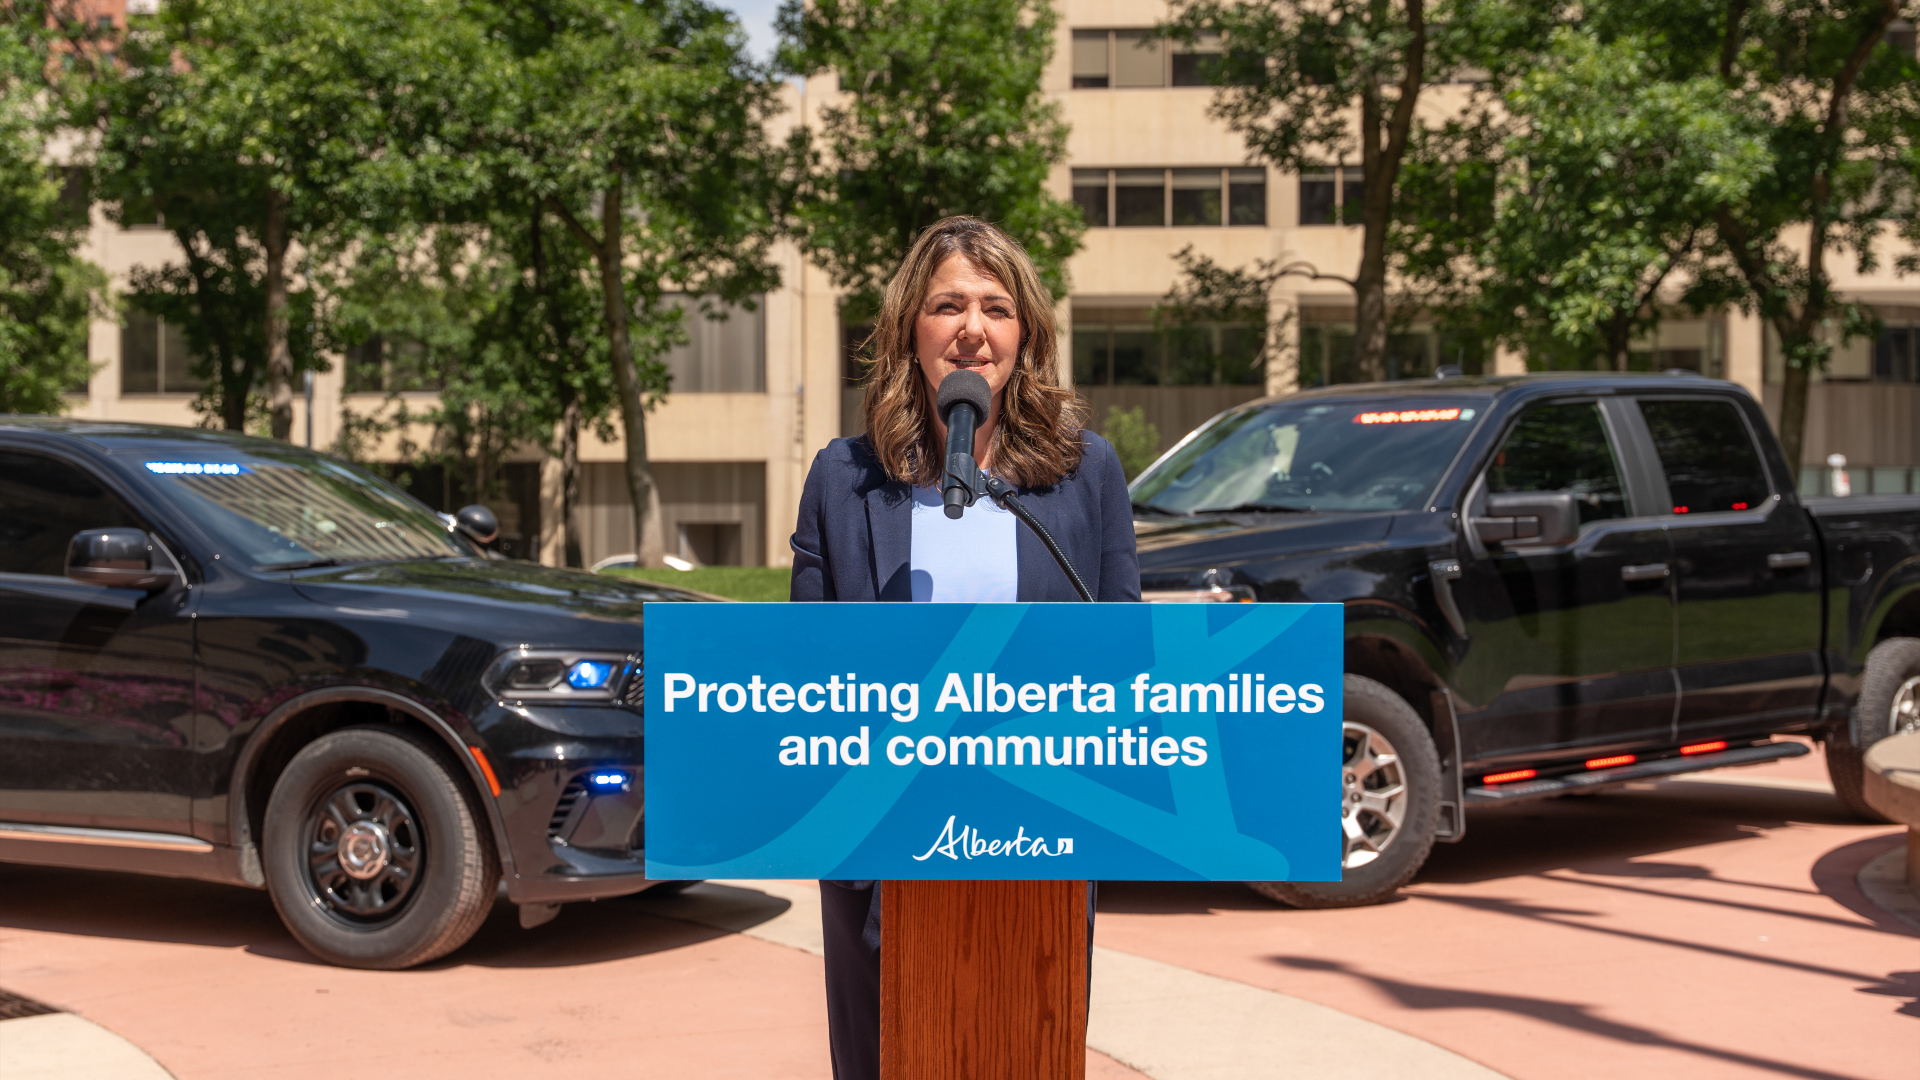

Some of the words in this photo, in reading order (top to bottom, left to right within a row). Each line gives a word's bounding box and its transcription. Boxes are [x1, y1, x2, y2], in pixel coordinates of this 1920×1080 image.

[665, 672, 919, 722] Protecting
[935, 672, 1116, 713] Alberta
[1130, 672, 1325, 713] families
[778, 726, 870, 766] and
[887, 726, 1208, 766] communities
[912, 815, 1064, 861] Alberta
